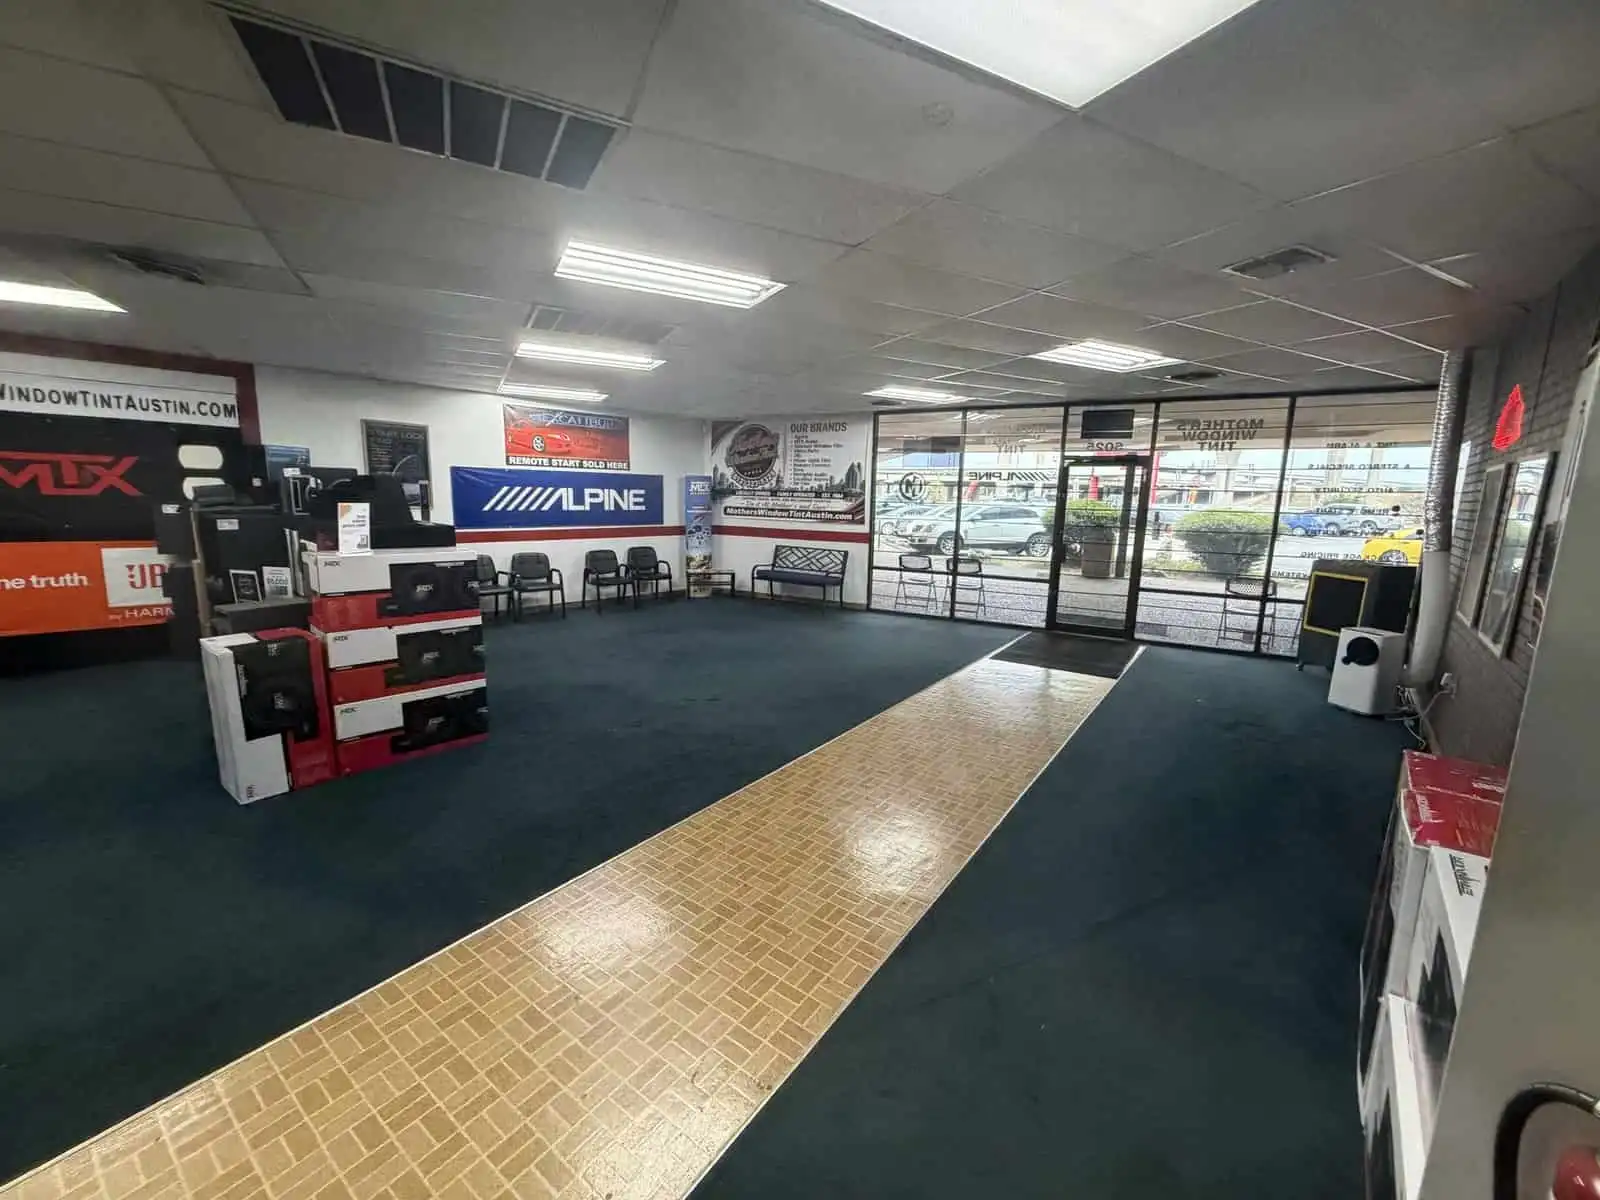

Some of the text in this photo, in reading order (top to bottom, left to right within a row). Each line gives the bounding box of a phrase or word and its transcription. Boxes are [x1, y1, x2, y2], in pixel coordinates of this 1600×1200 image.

[790, 421, 848, 433] OUR BRANDS
[509, 456, 629, 470] REMOTE START SOLD HERE
[0, 450, 144, 496] MTX
[540, 487, 646, 511] ALPINE
[726, 507, 853, 520] MothersWindowTintAustin.com
[31, 571, 89, 588] truth
